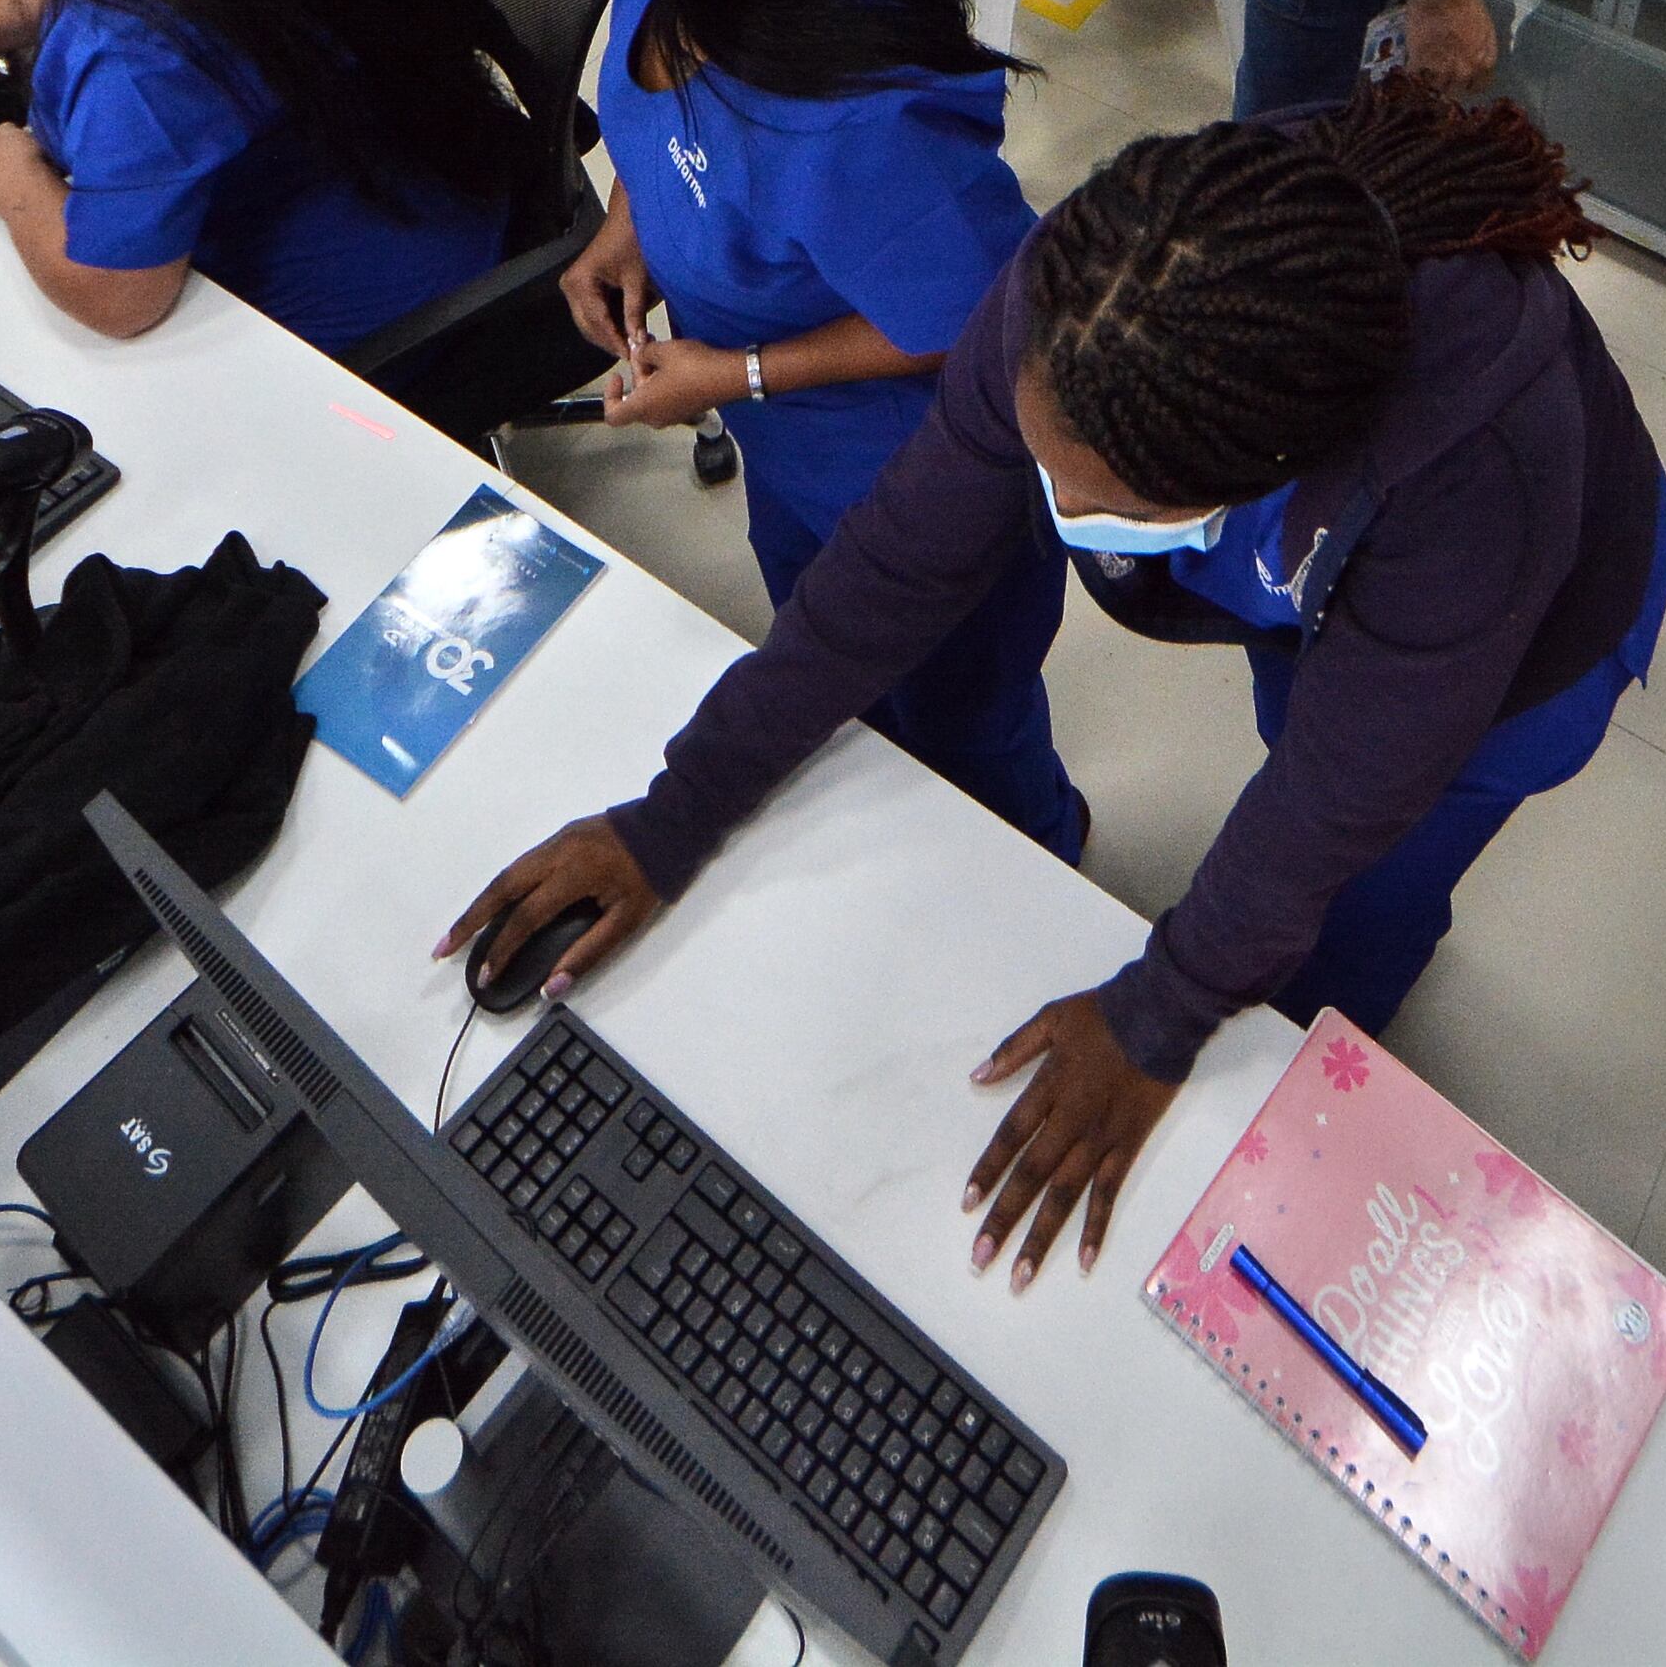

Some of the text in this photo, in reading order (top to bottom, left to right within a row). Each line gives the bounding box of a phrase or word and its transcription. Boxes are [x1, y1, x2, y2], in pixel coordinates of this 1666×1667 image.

[667, 136, 705, 209] Disfarma
[426, 637, 494, 696] 30
[120, 1117, 152, 1153] SAT
[1313, 1181, 1419, 1353] Do all
[1361, 1221, 1466, 1379] THINGS
